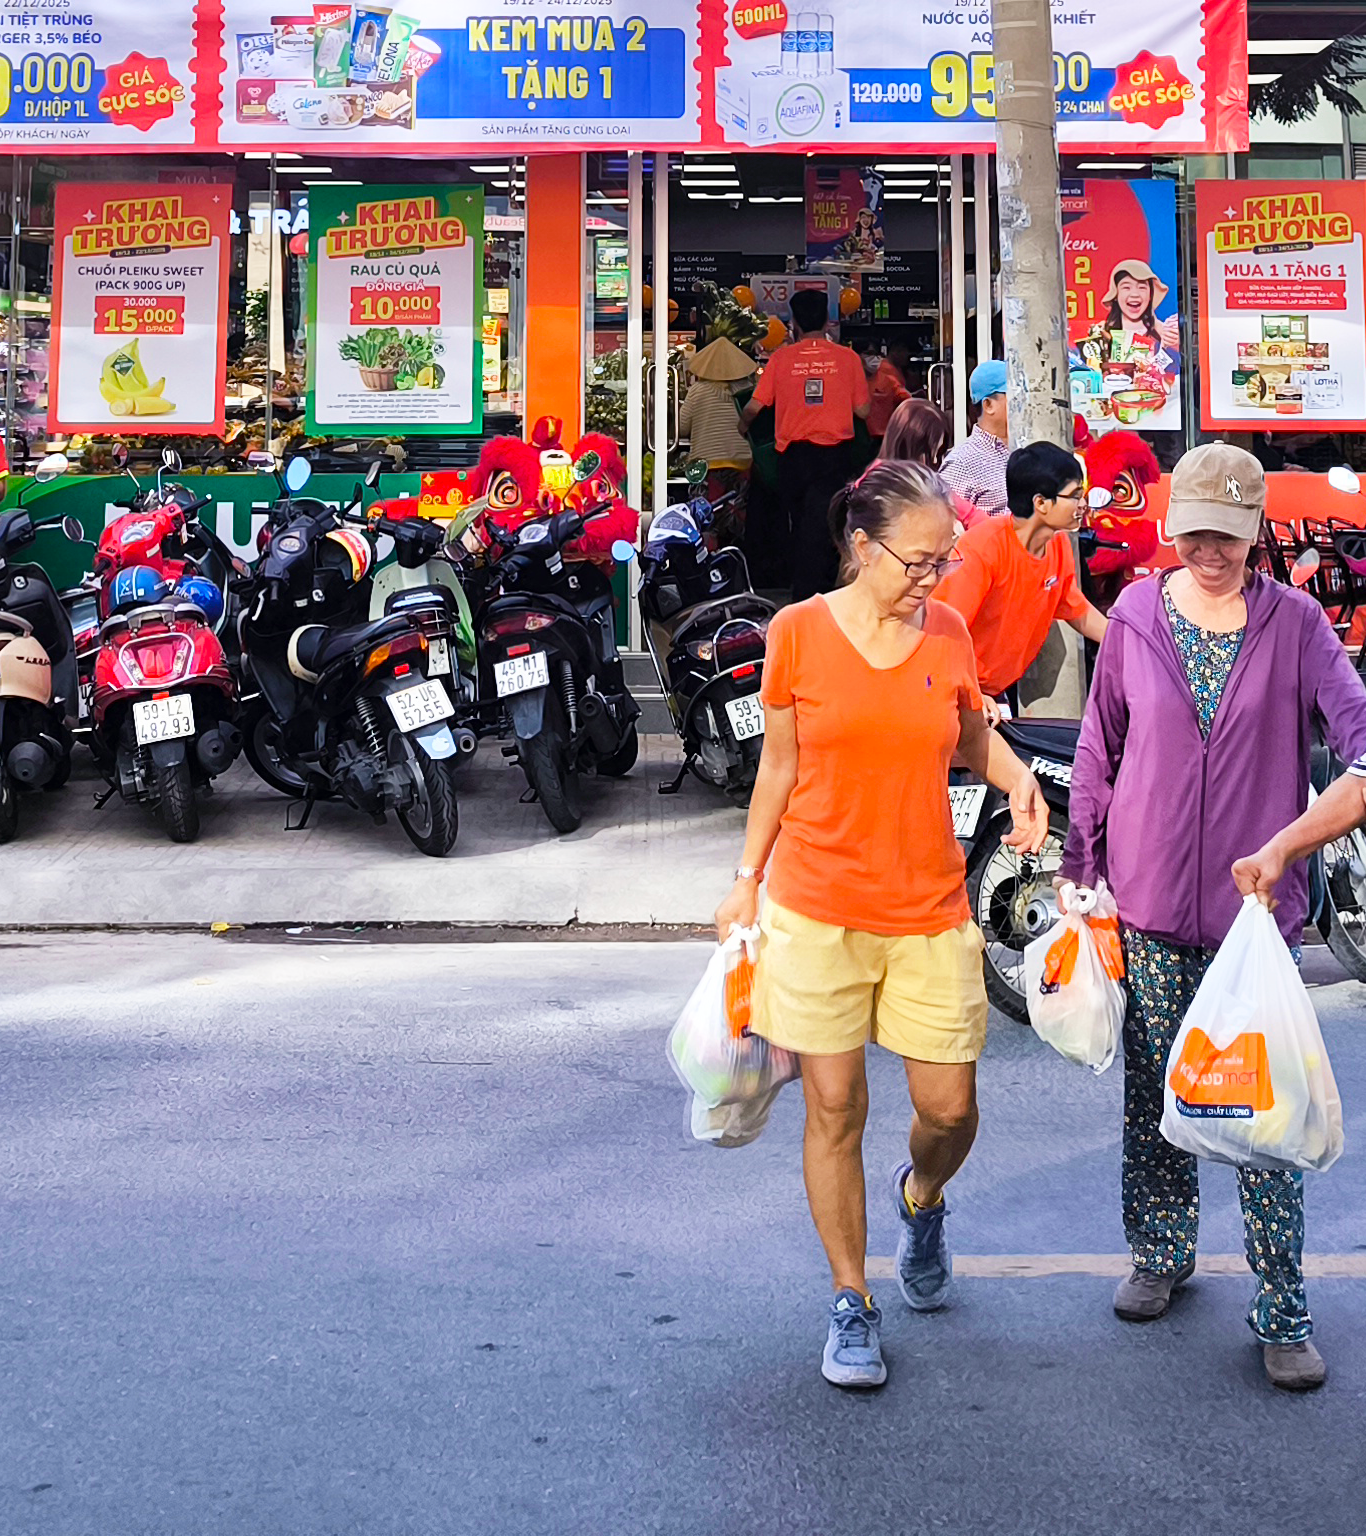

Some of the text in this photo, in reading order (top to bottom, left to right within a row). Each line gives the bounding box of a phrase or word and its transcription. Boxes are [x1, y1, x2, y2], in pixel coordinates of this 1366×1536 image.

[42, 11, 93, 27] TRÙNG
[735, 3, 784, 26] 500ML
[922, 10, 1096, 25] NƯỚC KHIẾT
[35, 33, 68, 46] 3,5%
[72, 29, 102, 45] BÉO
[241, 35, 274, 50] ORE
[466, 19, 646, 53] KEM MUA 2
[119, 69, 154, 88] GIÁ
[502, 59, 612, 110] TẶNG 1
[1130, 67, 1164, 86] GIÁ
[98, 83, 185, 115] CỰC SỐC
[852, 82, 922, 103] 120.000
[1110, 81, 1195, 113] CỰC SỐC
[75, 100, 89, 117] 1L
[780, 104, 820, 119] AQUAFINA
[1063, 100, 1105, 114] 24 CHAI
[105, 199, 182, 224] KHAI
[359, 200, 432, 225] KHAI
[813, 202, 847, 214] MUA 2
[1246, 196, 1319, 221] KHAI
[813, 214, 841, 229] TẶNG
[1218, 216, 1349, 246] TRƯƠNG
[75, 219, 207, 249] TRƯƠNG
[328, 220, 461, 251] TRƯƠNG
[1063, 231, 1099, 251] kem
[78, 263, 204, 276] CHUỐI PLEIKU SWEET
[351, 262, 441, 277] RAU CỦ QUẢ
[1074, 257, 1091, 284] 2
[1225, 261, 1347, 281] MUA 1 TẶNG 1
[95, 280, 186, 291] (PACK 900G UP)
[366, 279, 425, 291] ĐỒNG GIÁ
[762, 286, 788, 302] X3
[123, 298, 156, 307] 30.000
[360, 296, 432, 320] 10.000
[1086, 291, 1095, 319] 1
[104, 308, 176, 332] 15.000
[499, 669, 545, 695] 260.75
[396, 685, 437, 709] 52-U6
[142, 699, 183, 720] 59-L2
[403, 700, 445, 726] 5255
[141, 716, 191, 740] 482.93
